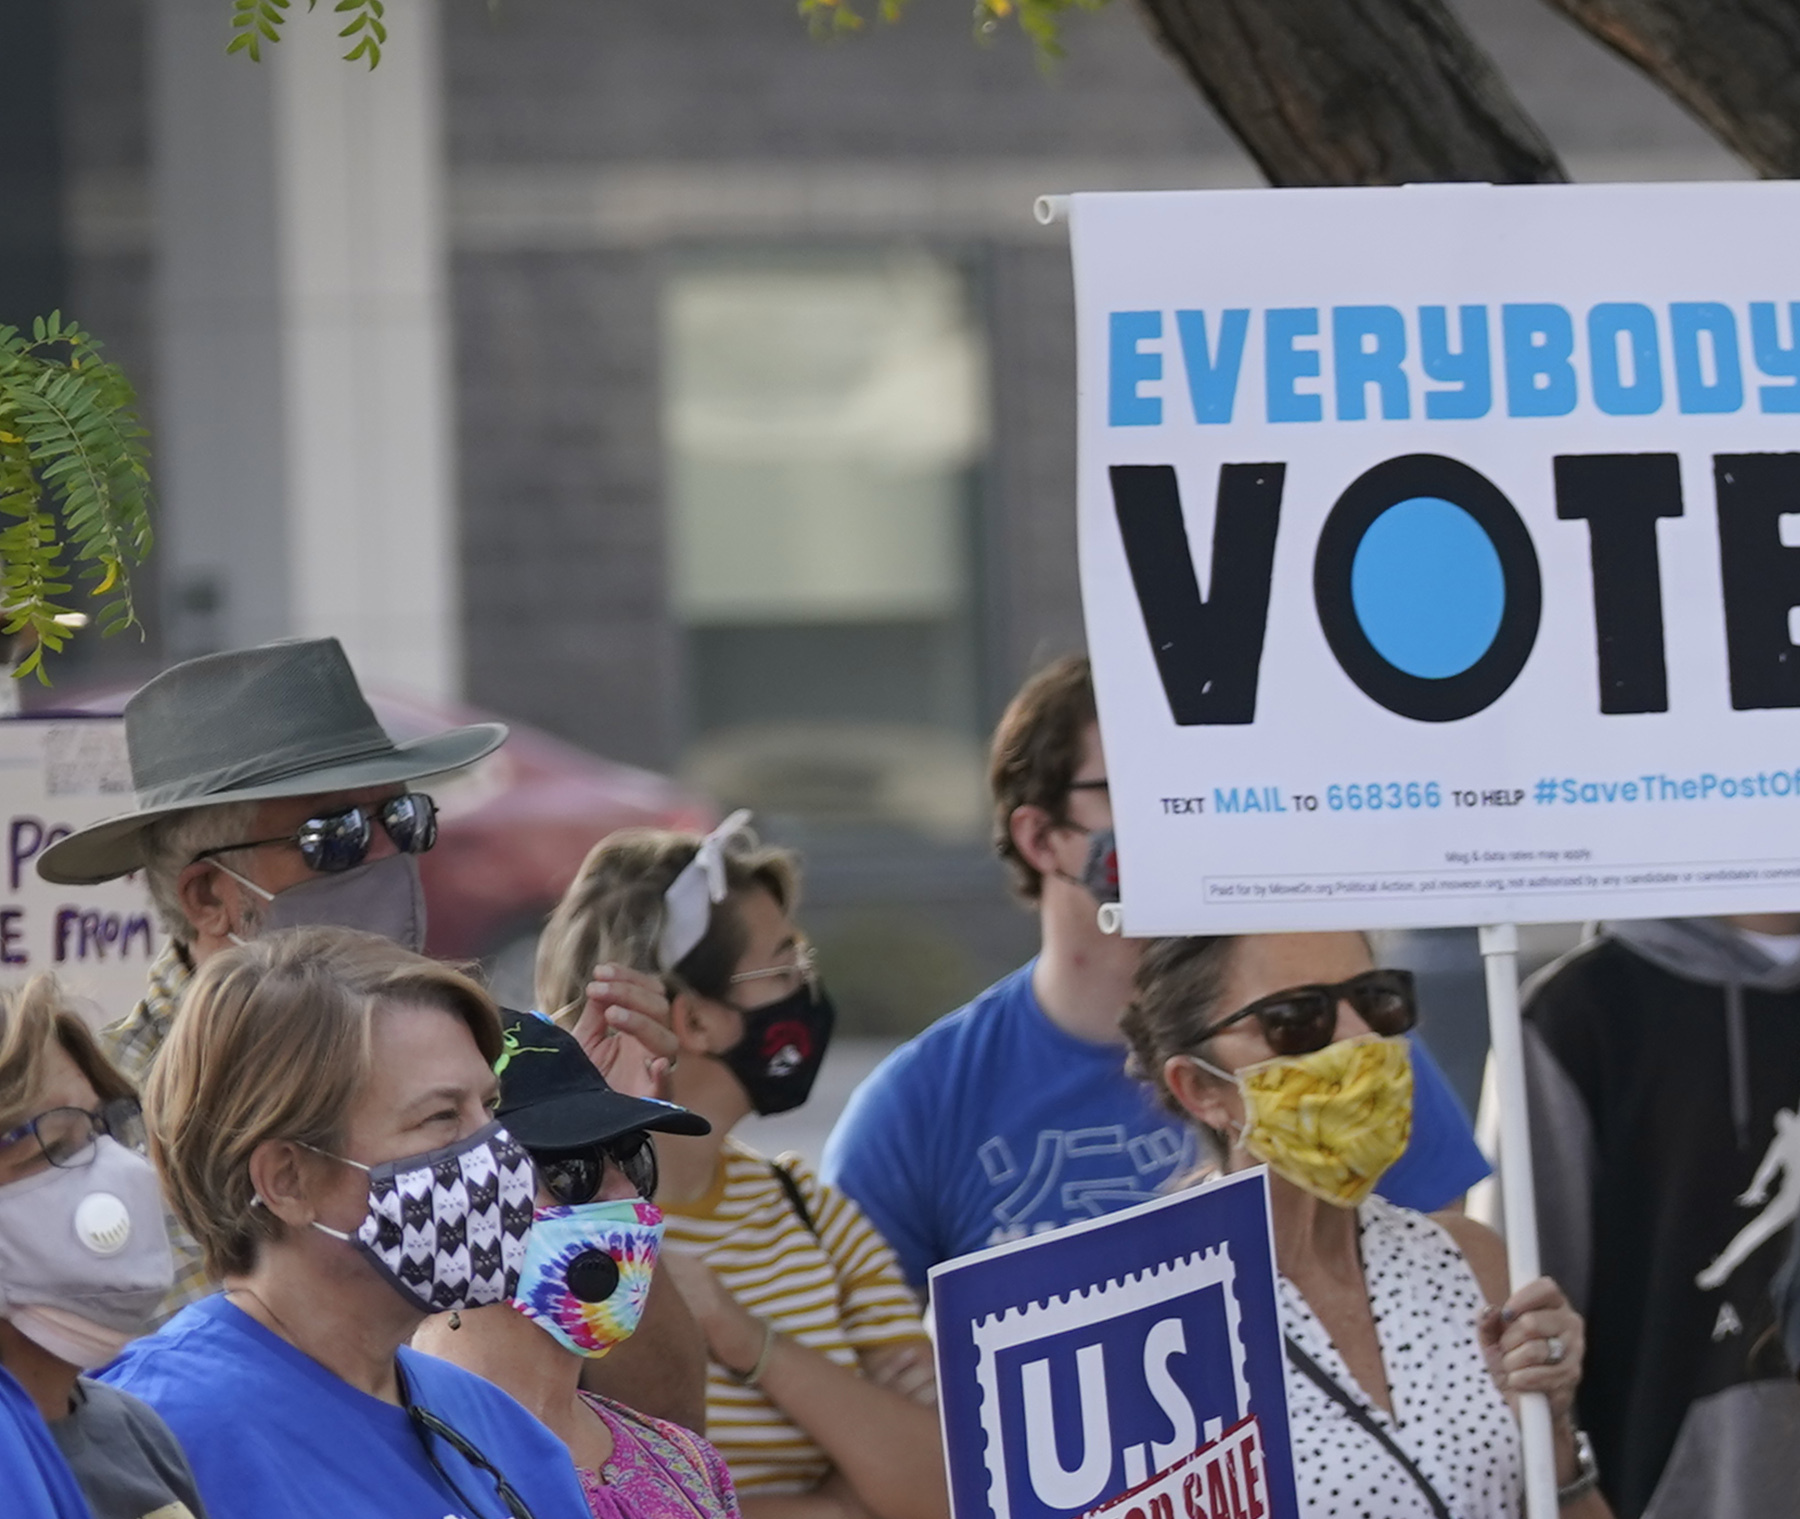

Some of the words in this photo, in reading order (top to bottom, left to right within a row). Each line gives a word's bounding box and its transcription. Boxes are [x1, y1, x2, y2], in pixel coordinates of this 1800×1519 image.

[1160, 798, 1205, 815] TEXT
[1213, 787, 1288, 814] MAIL
[1292, 795, 1319, 812] TO
[1326, 781, 1442, 811] 668366
[1452, 790, 1479, 808] TO
[1481, 788, 1525, 806] HELP
[55, 908, 153, 962] FROM
[1021, 1318, 1223, 1510] U.S.
